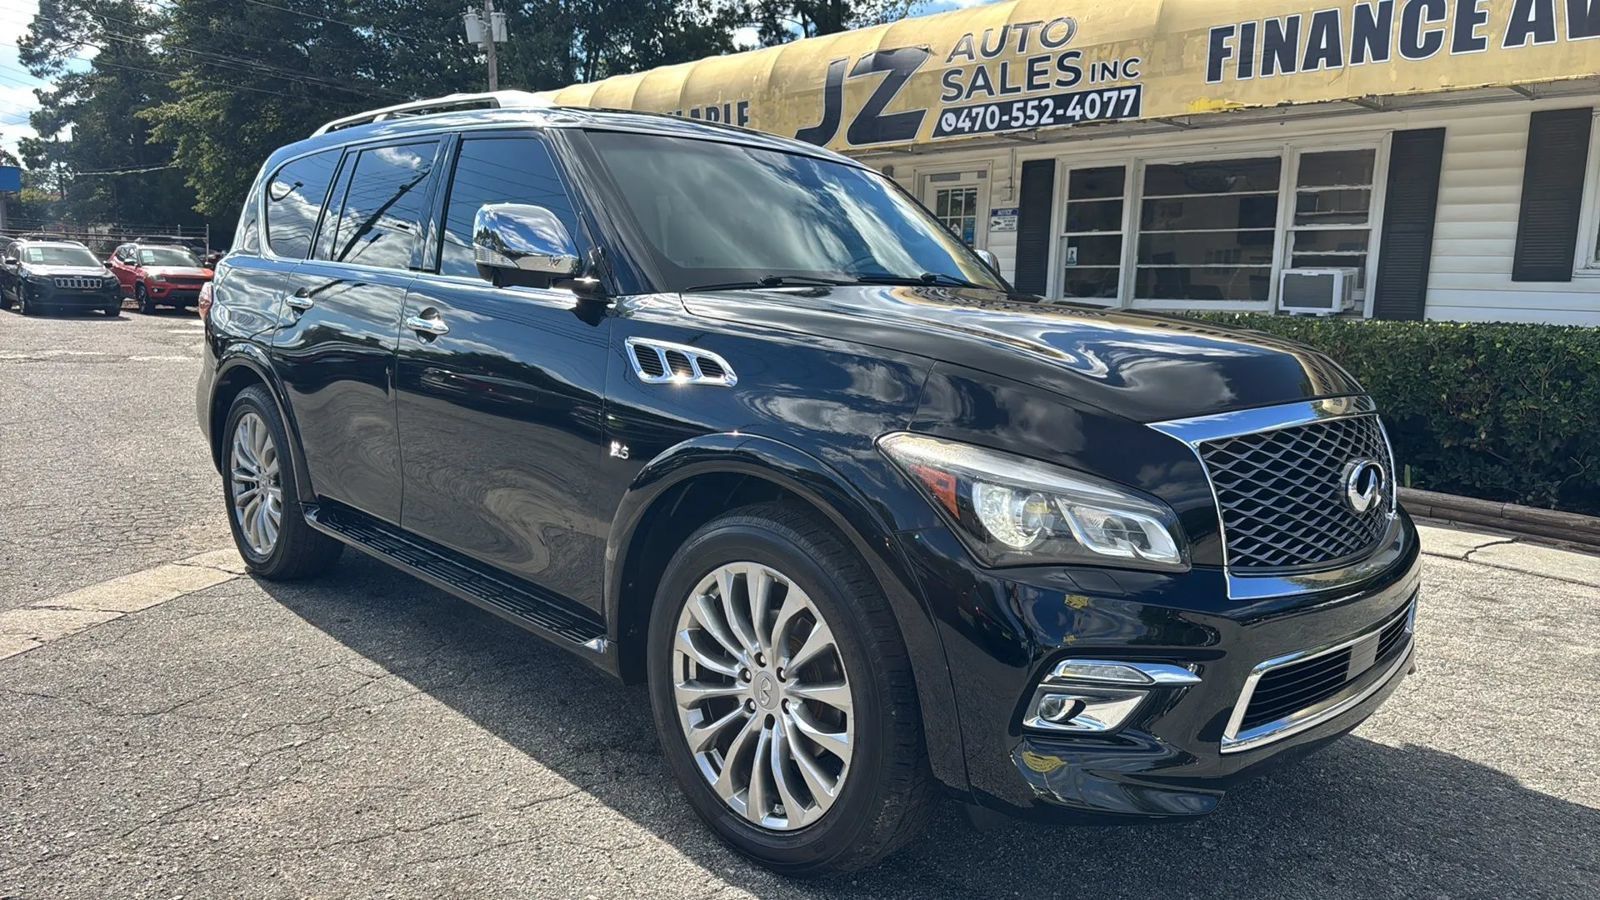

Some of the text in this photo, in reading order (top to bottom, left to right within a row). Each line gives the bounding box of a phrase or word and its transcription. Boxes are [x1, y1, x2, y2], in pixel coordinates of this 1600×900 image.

[945, 16, 1078, 63] AUTO
[1205, 0, 1489, 84] FINANCE
[794, 46, 930, 147] JZ
[941, 51, 1142, 102] SALES INC
[956, 88, 1137, 132] 470-552-4077
